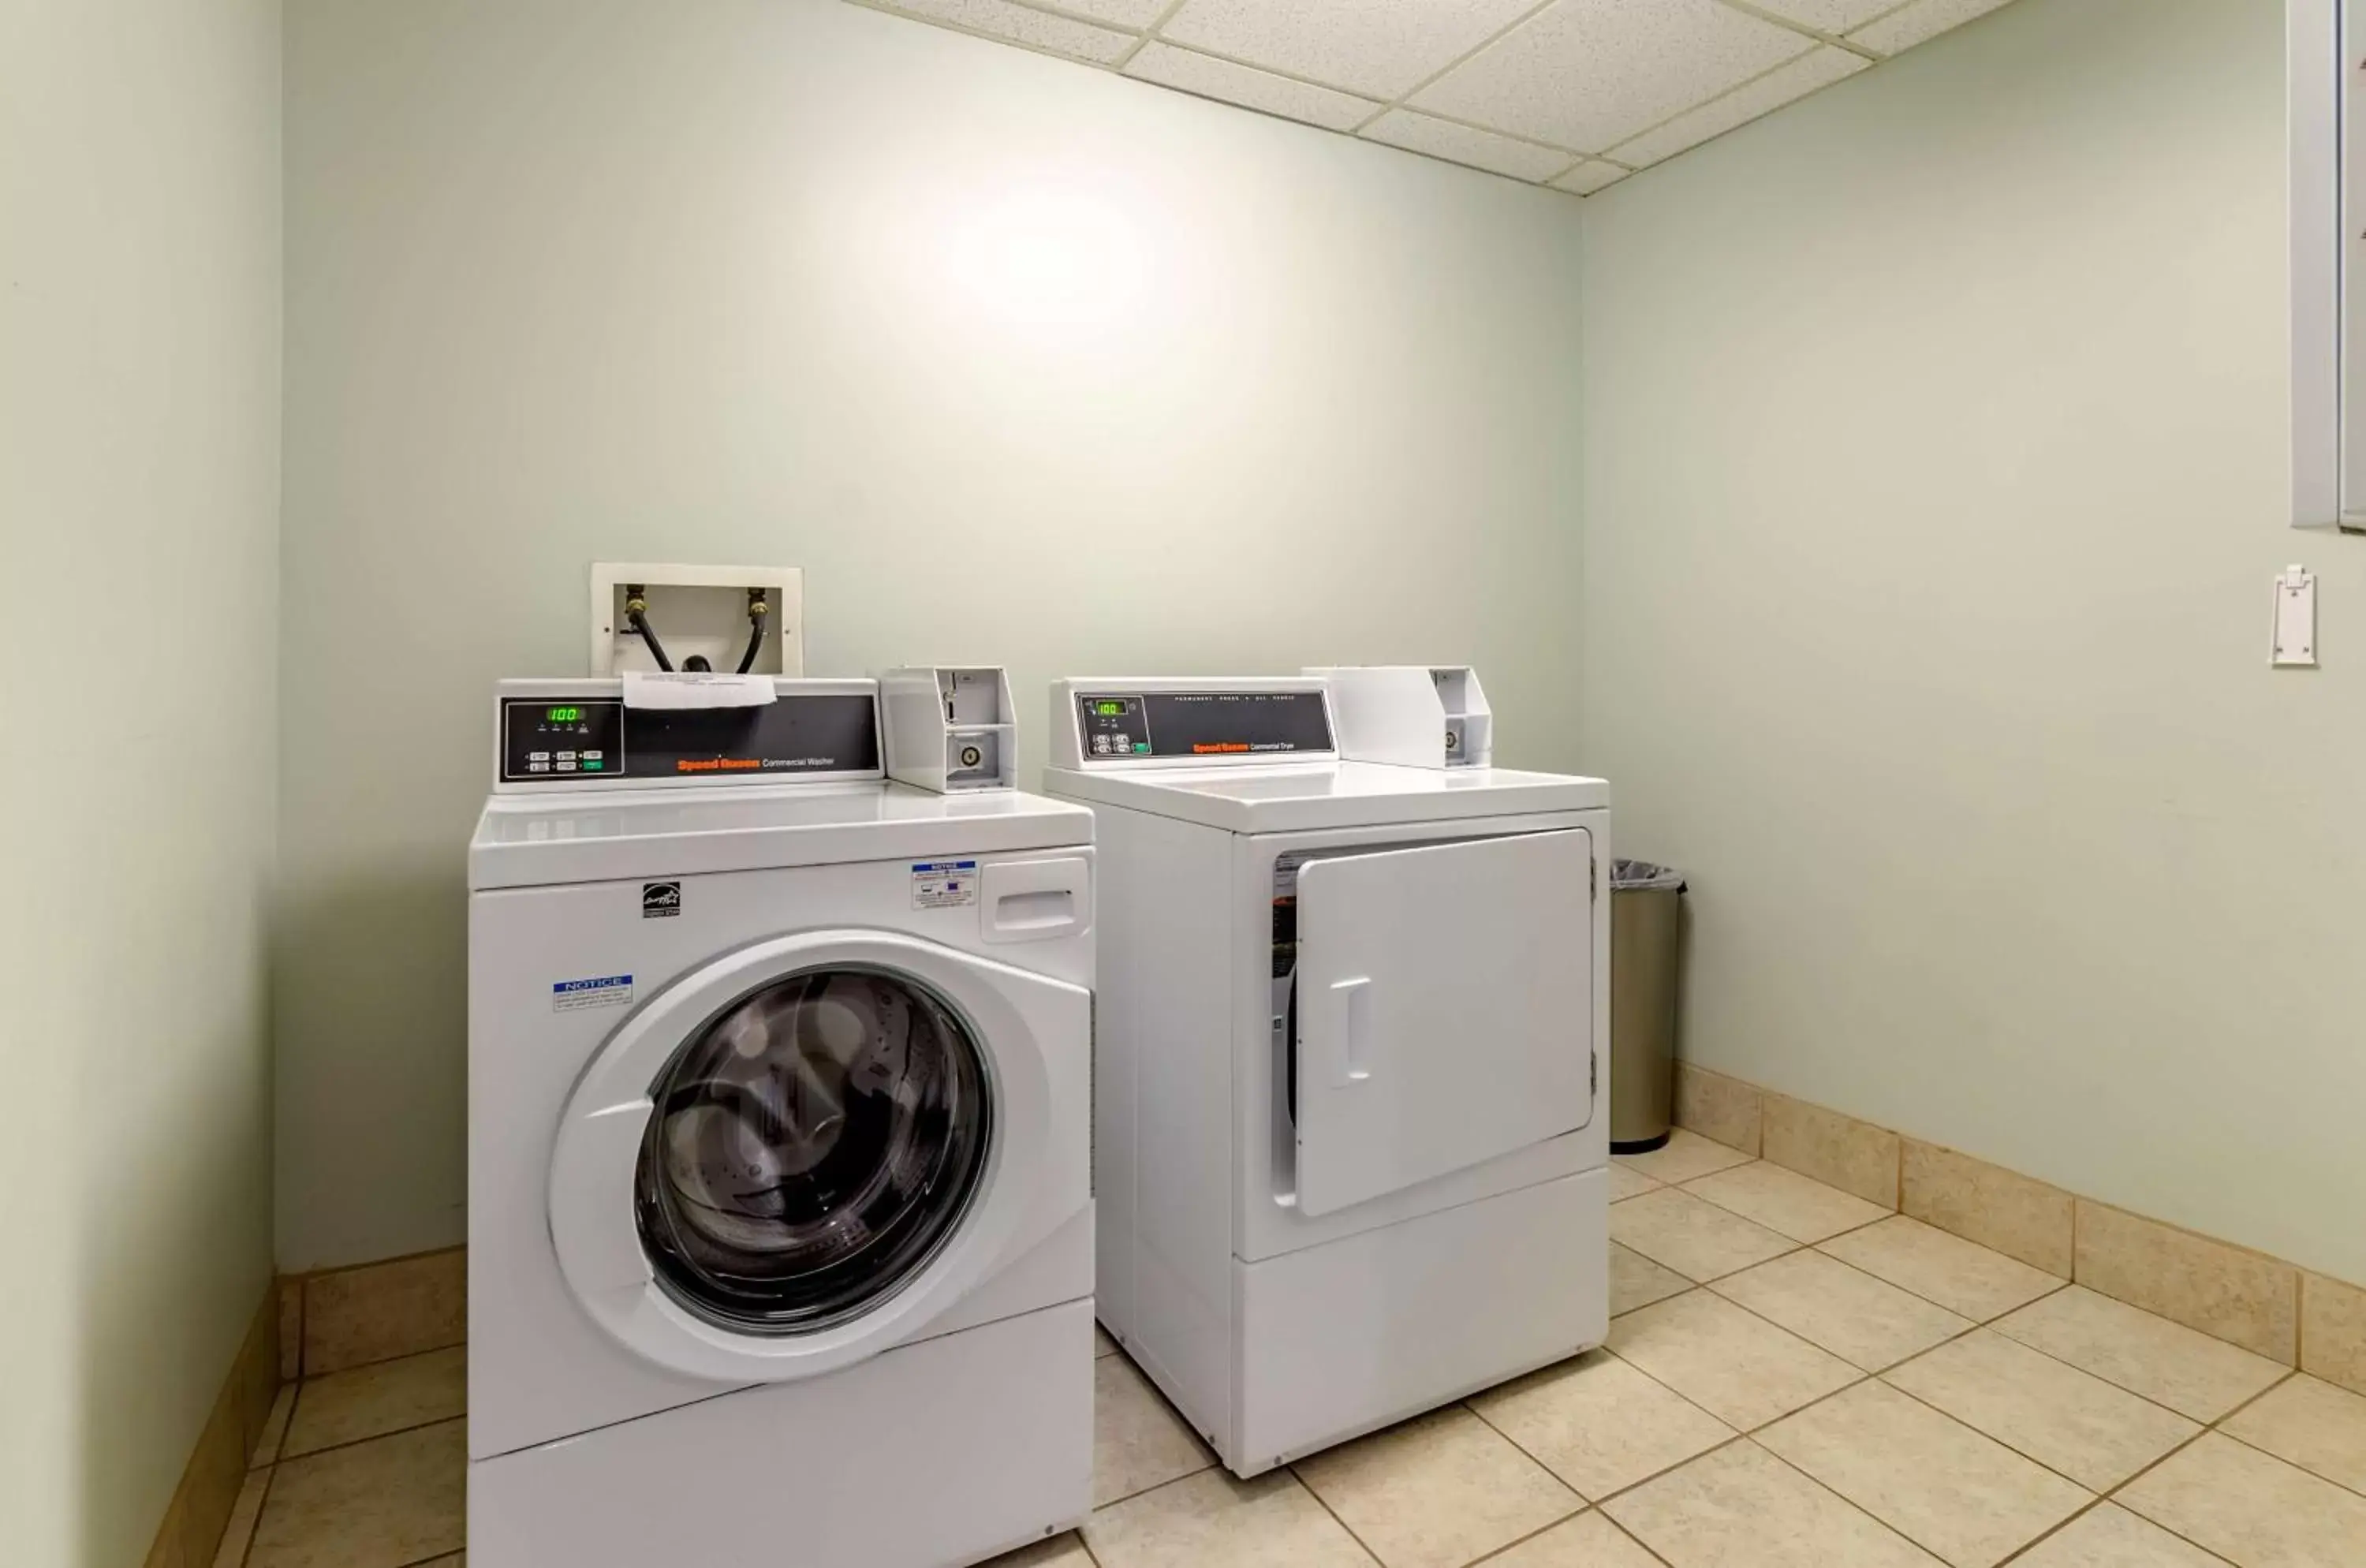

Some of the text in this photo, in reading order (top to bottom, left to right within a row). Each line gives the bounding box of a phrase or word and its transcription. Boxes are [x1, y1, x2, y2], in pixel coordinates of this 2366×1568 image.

[551, 708, 577, 720] 100
[1100, 704, 1116, 714] 100
[677, 760, 718, 771] Speed
[762, 758, 806, 767] Commercial
[807, 757, 834, 766] Washer
[565, 977, 621, 991] NOTICE
